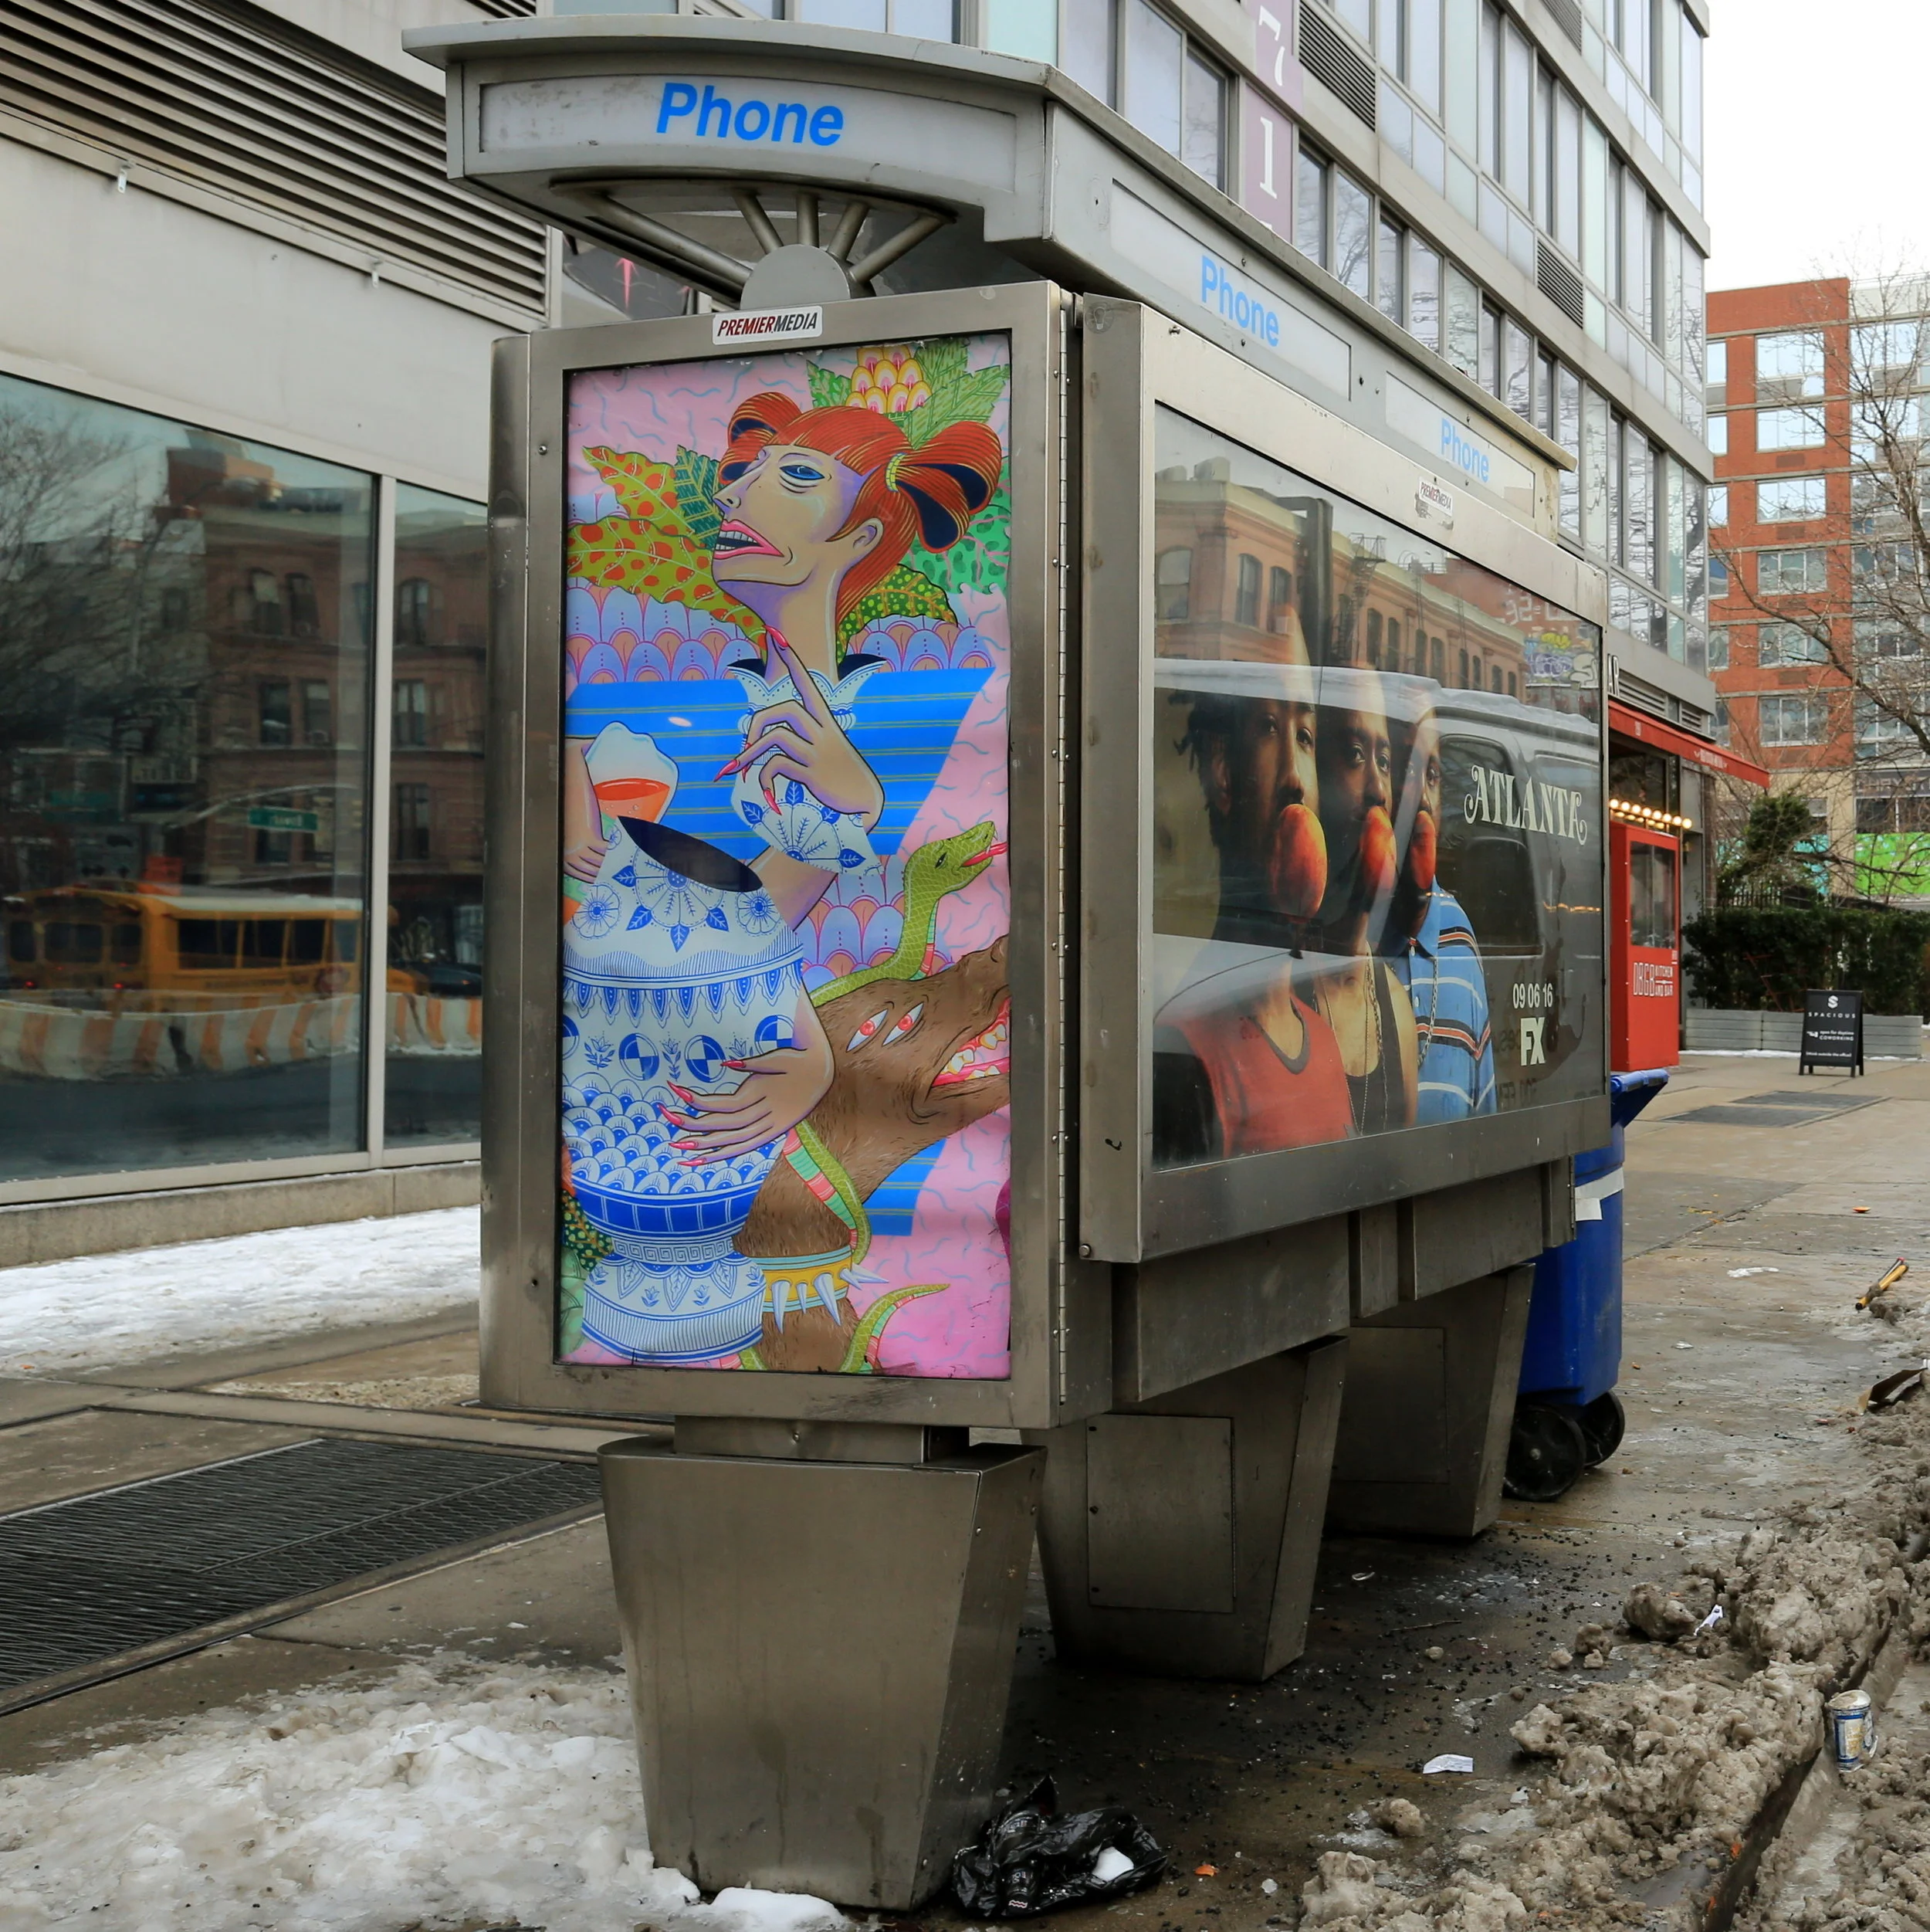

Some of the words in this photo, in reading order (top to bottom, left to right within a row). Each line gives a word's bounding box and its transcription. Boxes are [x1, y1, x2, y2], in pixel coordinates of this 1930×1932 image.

[656, 82, 844, 146] Phone
[717, 313, 818, 336] PREMIERMEDIA
[1201, 255, 1279, 347] Phone
[1441, 418, 1489, 483] Phone
[1464, 764, 1588, 846] ATLANTA
[1512, 983, 1525, 1009] 09
[1528, 983, 1540, 1008] 06
[1543, 983, 1553, 1007] 16
[1520, 1017, 1546, 1066] FX
